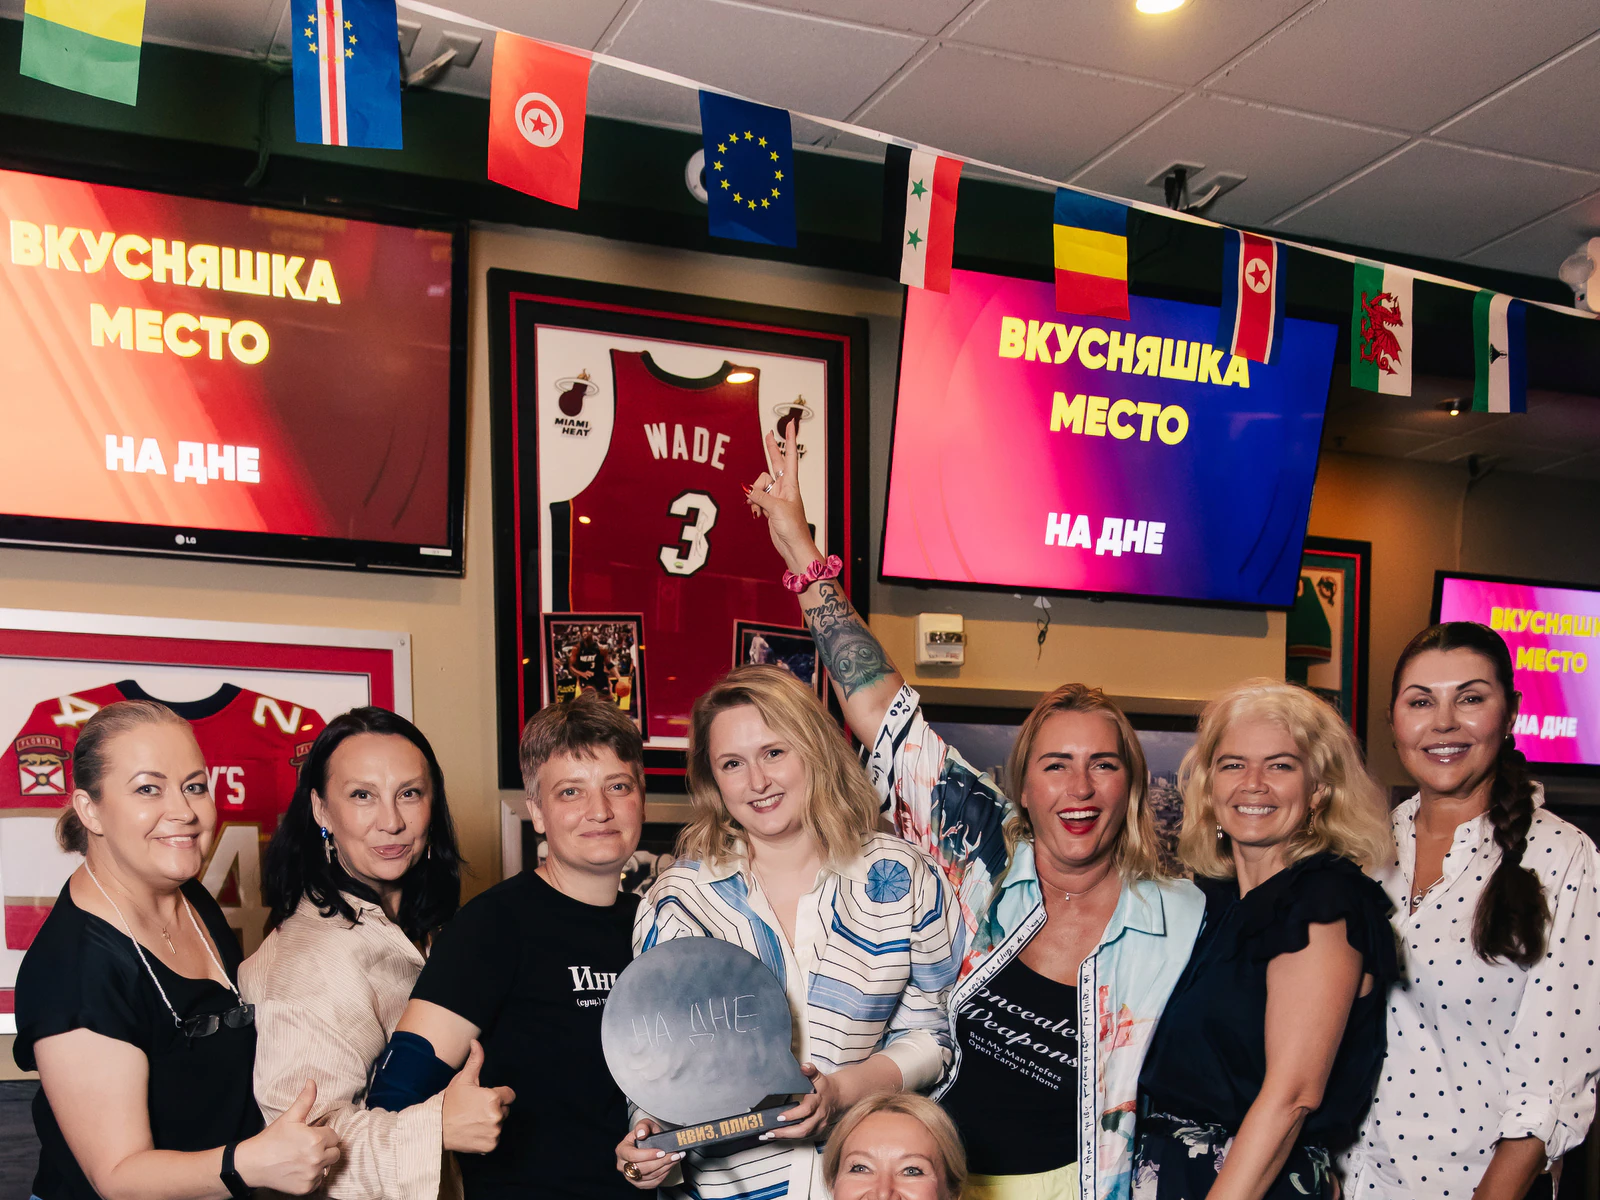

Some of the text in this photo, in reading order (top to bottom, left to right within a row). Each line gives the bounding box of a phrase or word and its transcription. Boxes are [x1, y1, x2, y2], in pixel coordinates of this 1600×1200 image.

[10, 219, 341, 305] ВКУСНЯШКА
[90, 303, 270, 365] МЕСТО
[998, 315, 1251, 389] ВКУСНЯШКА
[555, 418, 589, 428] MIAMI
[562, 427, 592, 437] HEAT
[1049, 391, 1190, 446] МЕСТО
[105, 434, 260, 484] НА ДНЕ
[644, 422, 731, 471] WADE
[656, 488, 720, 578] 3
[1045, 512, 1167, 557] НА ДНЕ
[1516, 646, 1588, 674] МЕСТО
[252, 695, 302, 735] 2
[890, 684, 914, 717] erão
[1513, 714, 1578, 740] НА ДНЕ
[631, 994, 760, 1047] НА ДНЕ
[959, 1001, 1079, 1067] Weapons
[976, 987, 1079, 1041] onceale
[968, 1038, 1059, 1091] Open Carry at Home
[969, 1031, 1062, 1082] But My Man Prefers
[676, 1113, 764, 1147] КВИЗ, ПЛИЗ!
